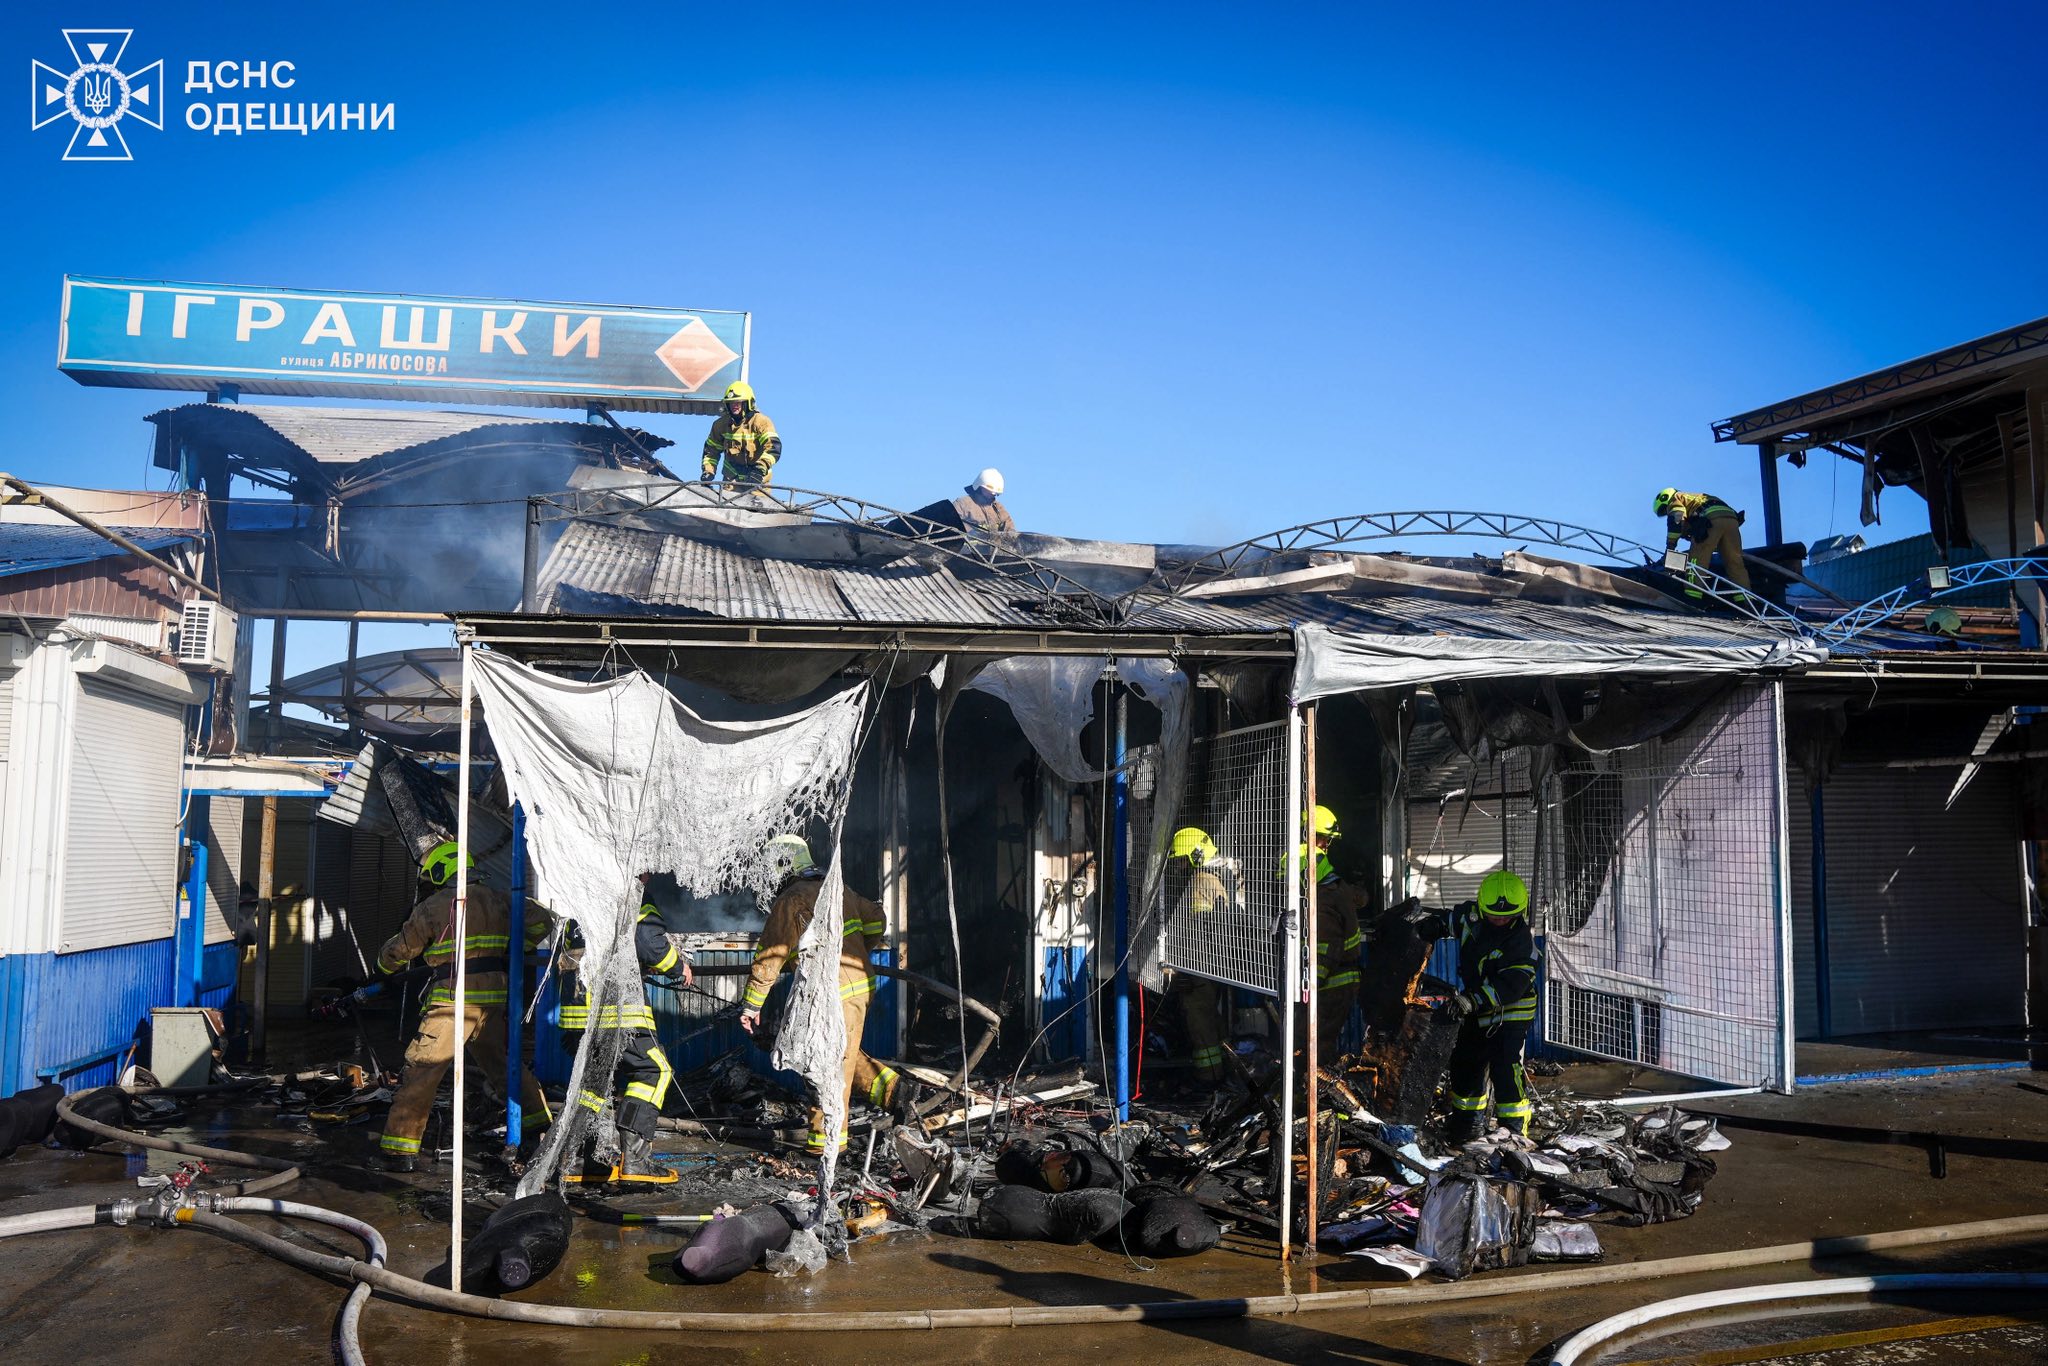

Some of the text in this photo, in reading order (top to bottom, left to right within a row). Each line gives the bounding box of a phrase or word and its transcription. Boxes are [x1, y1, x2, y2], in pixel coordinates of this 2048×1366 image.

[126, 292, 602, 359] ІГРАШКИ
[329, 351, 448, 374] АБРИКОСОВА
[1499, 900, 1505, 909] 7
